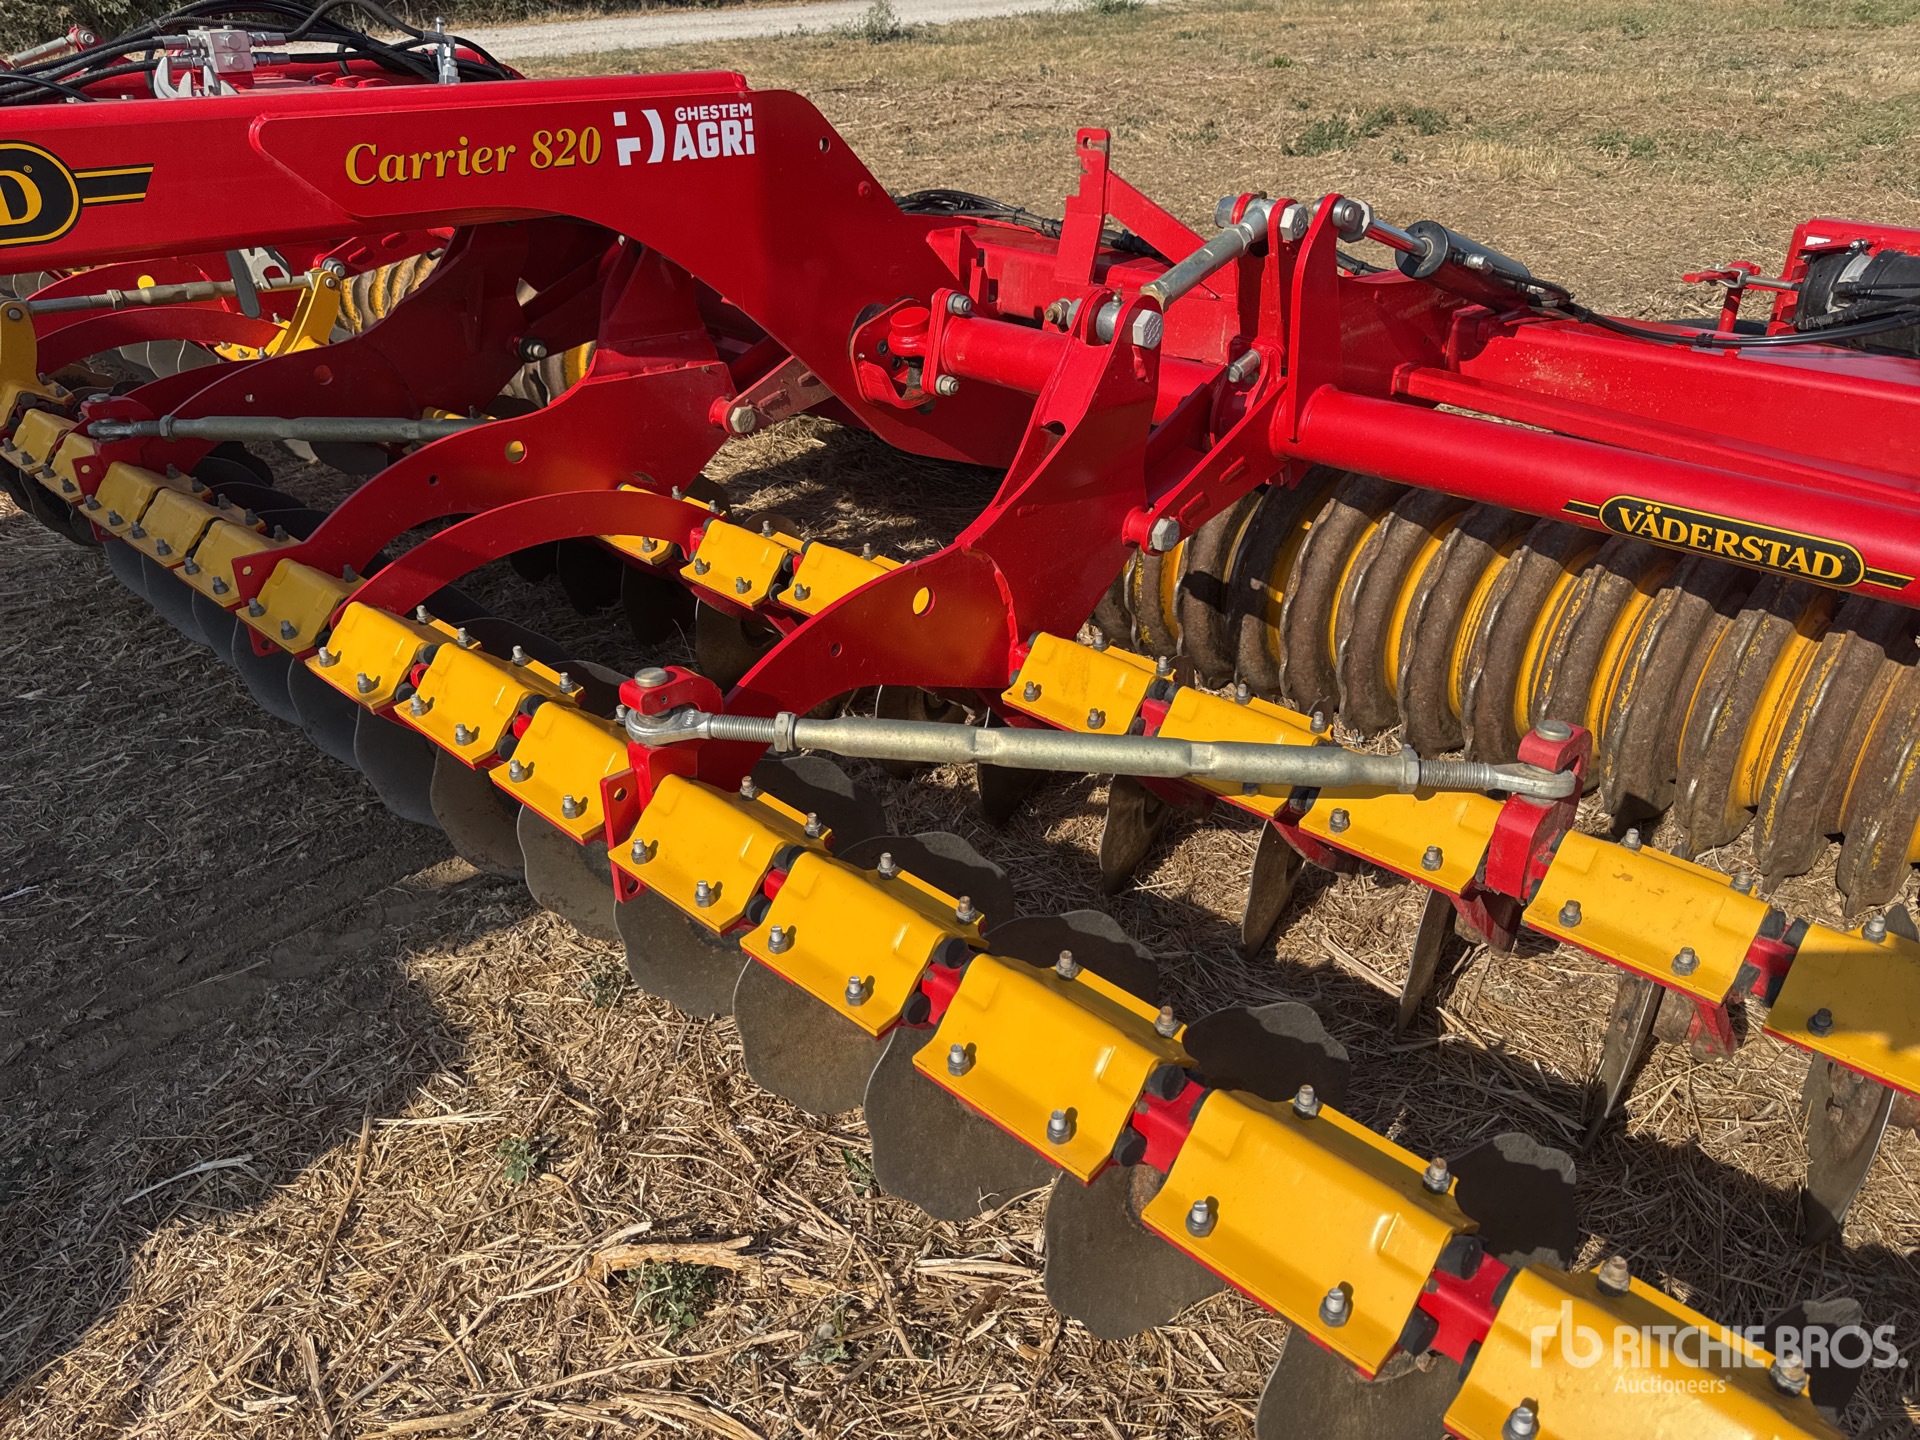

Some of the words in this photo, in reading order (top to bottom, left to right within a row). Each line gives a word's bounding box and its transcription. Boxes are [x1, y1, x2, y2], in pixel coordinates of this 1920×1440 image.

[674, 102, 753, 122] GHESTEM
[345, 135, 517, 186] Carrier
[529, 126, 602, 170] 820
[1617, 504, 1845, 580] VÄDERSTAD
